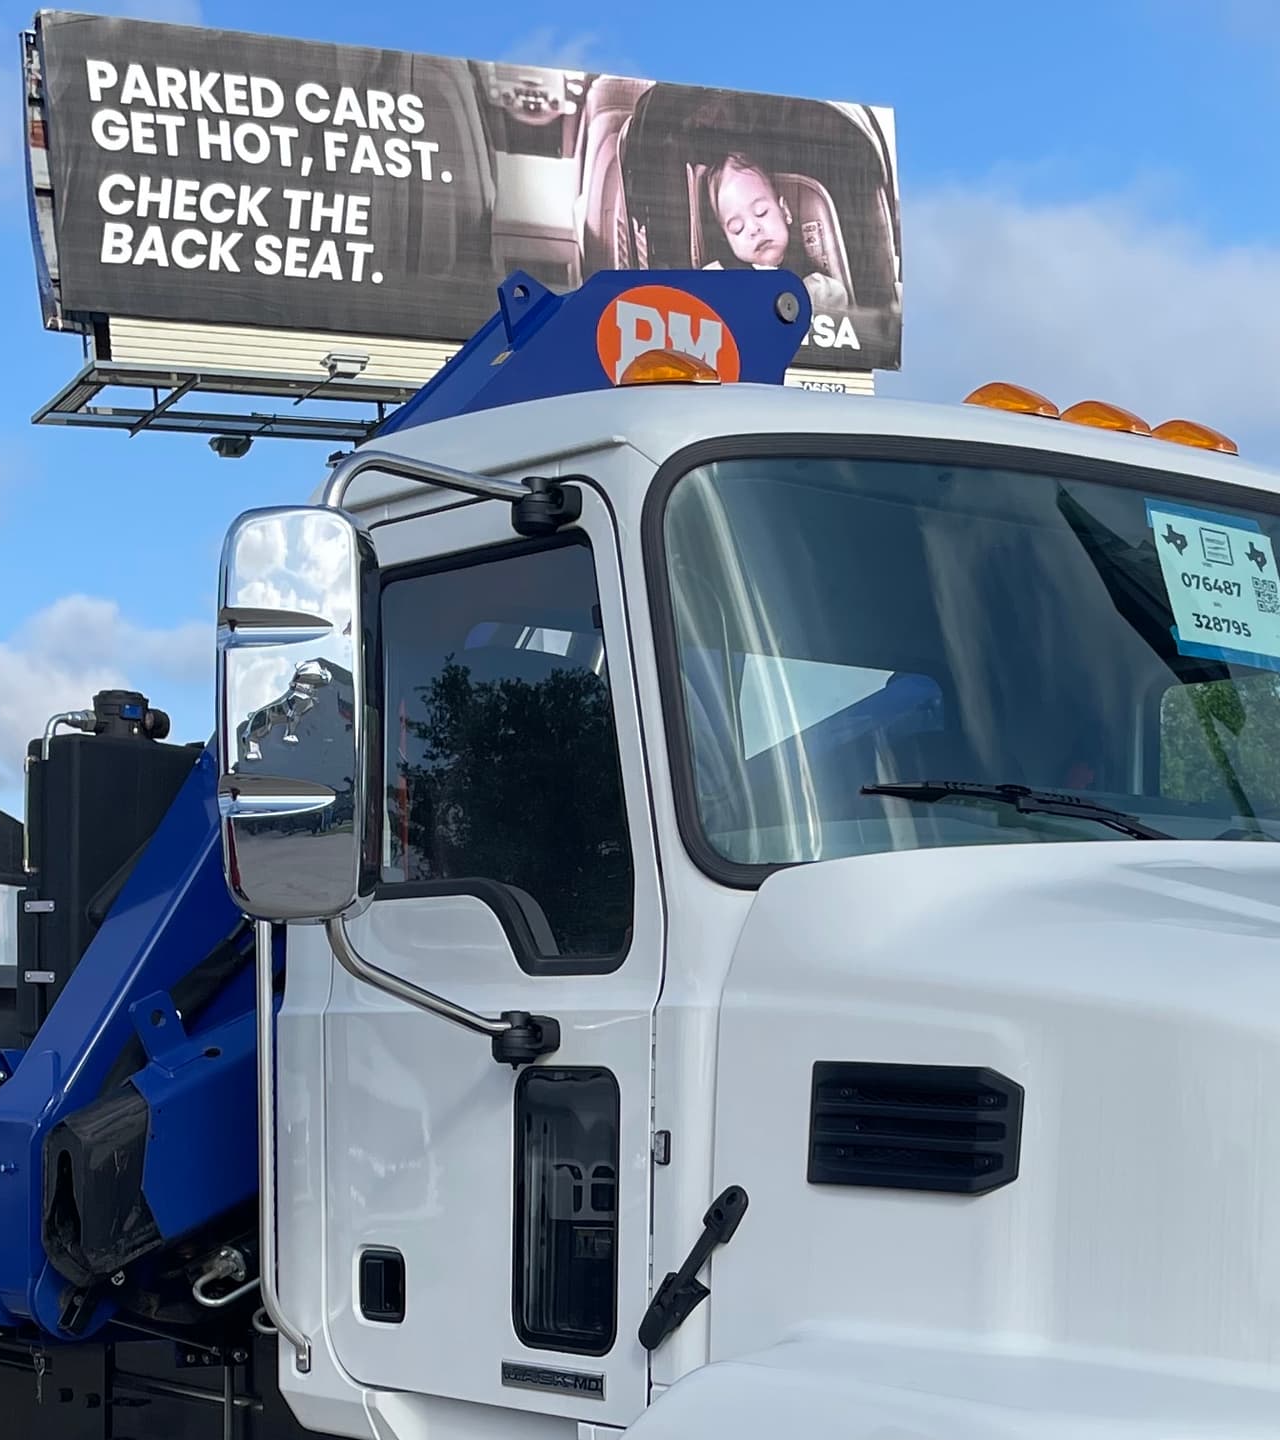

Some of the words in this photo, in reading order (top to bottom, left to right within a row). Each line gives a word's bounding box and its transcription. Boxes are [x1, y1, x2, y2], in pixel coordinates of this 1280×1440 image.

[86, 59, 284, 118] PARKED
[295, 82, 425, 134] CARS
[91, 108, 186, 157] GET
[197, 117, 313, 177] HOT,
[323, 131, 453, 183] FAST.
[98, 173, 272, 227] CHECK
[283, 188, 371, 236] THE
[100, 221, 244, 272] BACK
[254, 234, 384, 283] SEAT.
[801, 314, 861, 350] SA
[1181, 572, 1242, 598] 076487
[1192, 613, 1252, 637] 328795
[573, 1376, 600, 1392] MD
